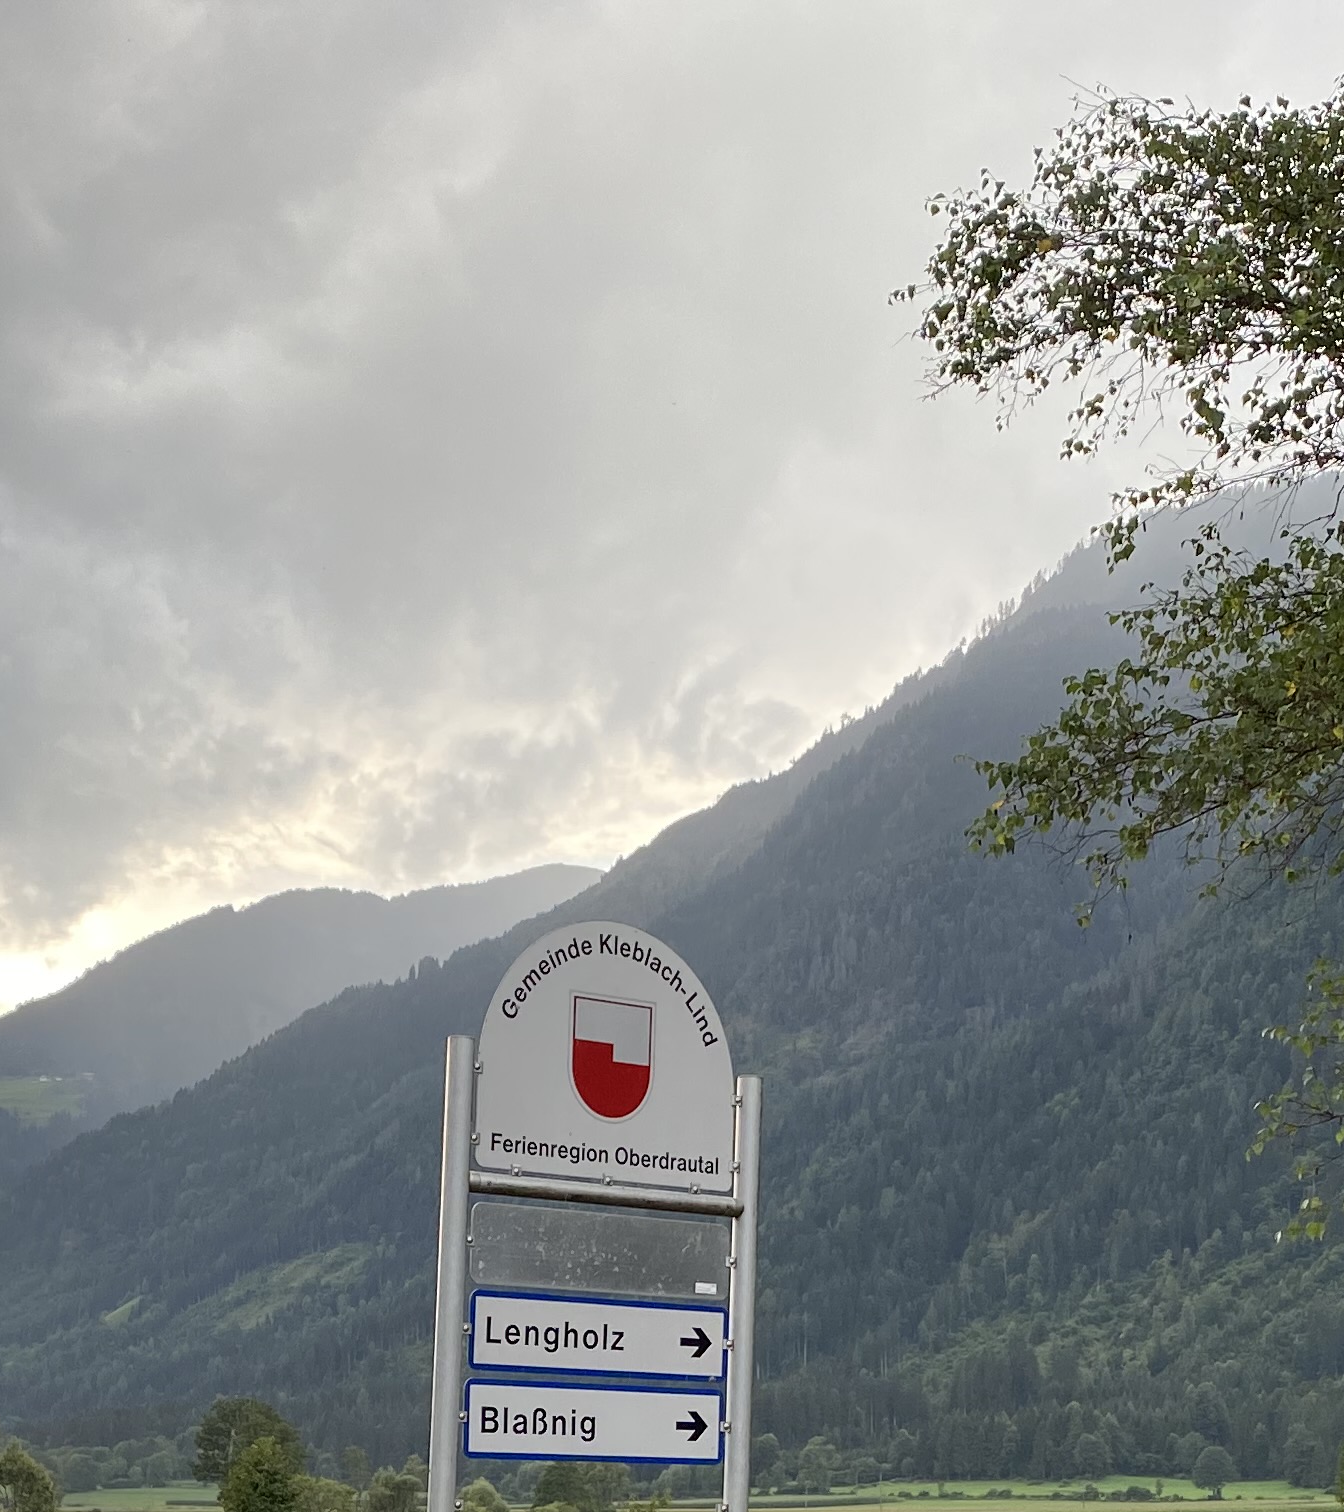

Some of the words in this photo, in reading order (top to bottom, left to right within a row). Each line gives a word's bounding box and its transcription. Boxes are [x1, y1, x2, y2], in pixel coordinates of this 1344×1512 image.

[501, 937, 593, 1020] Gemeinde
[599, 933, 719, 1048] Kleblach-Lind
[490, 1131, 609, 1165] Ferienregion
[614, 1146, 719, 1175] Oberdrautal
[485, 1316, 625, 1353] Lengholz
[480, 1406, 596, 1442] Blaßnig
